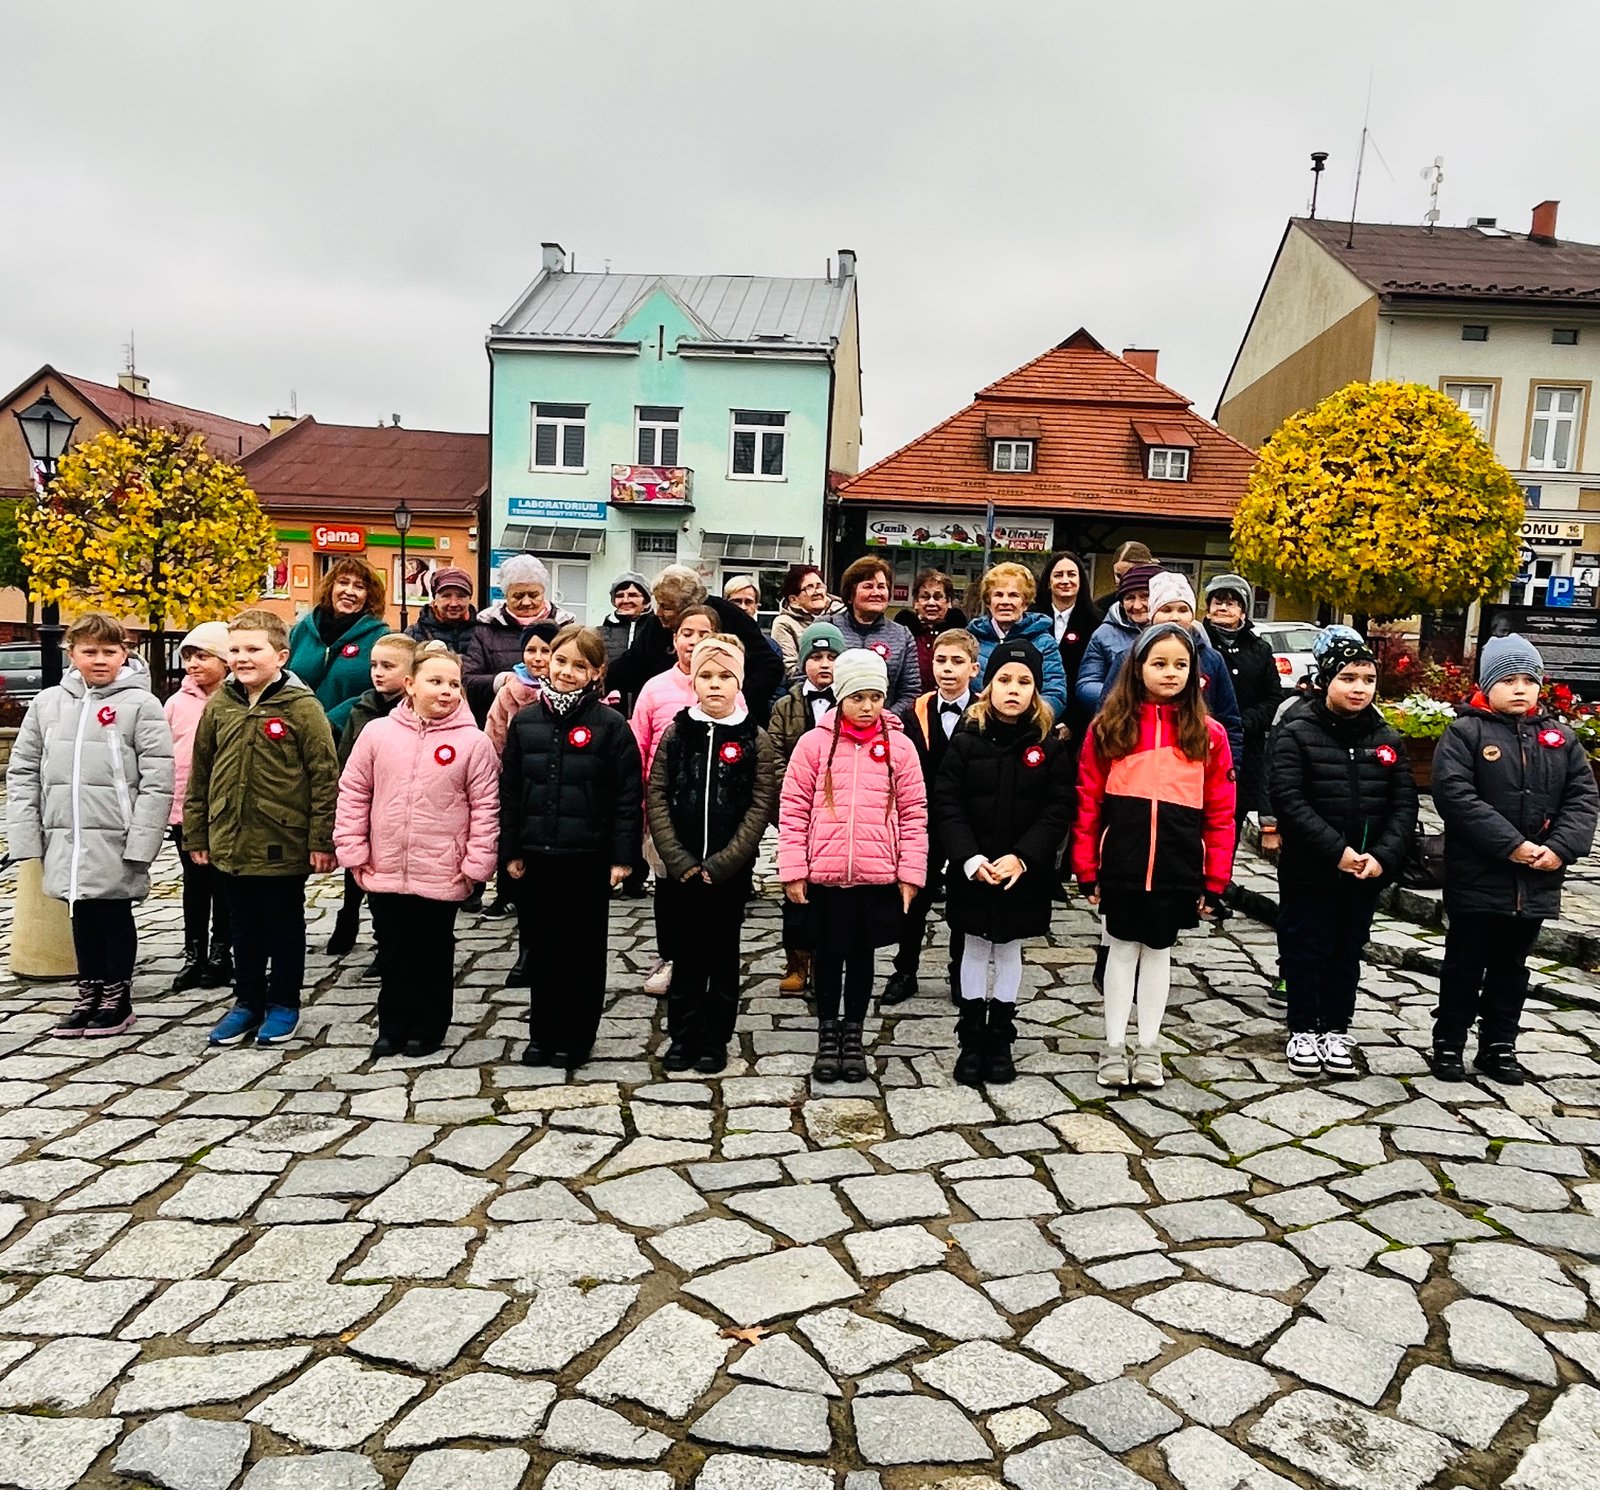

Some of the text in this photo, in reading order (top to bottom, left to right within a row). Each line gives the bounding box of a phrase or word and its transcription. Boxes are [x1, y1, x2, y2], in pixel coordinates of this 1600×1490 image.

[518, 499, 598, 511] LABORATORIUM
[877, 523, 907, 533] Janik
[1553, 578, 1570, 598] P
